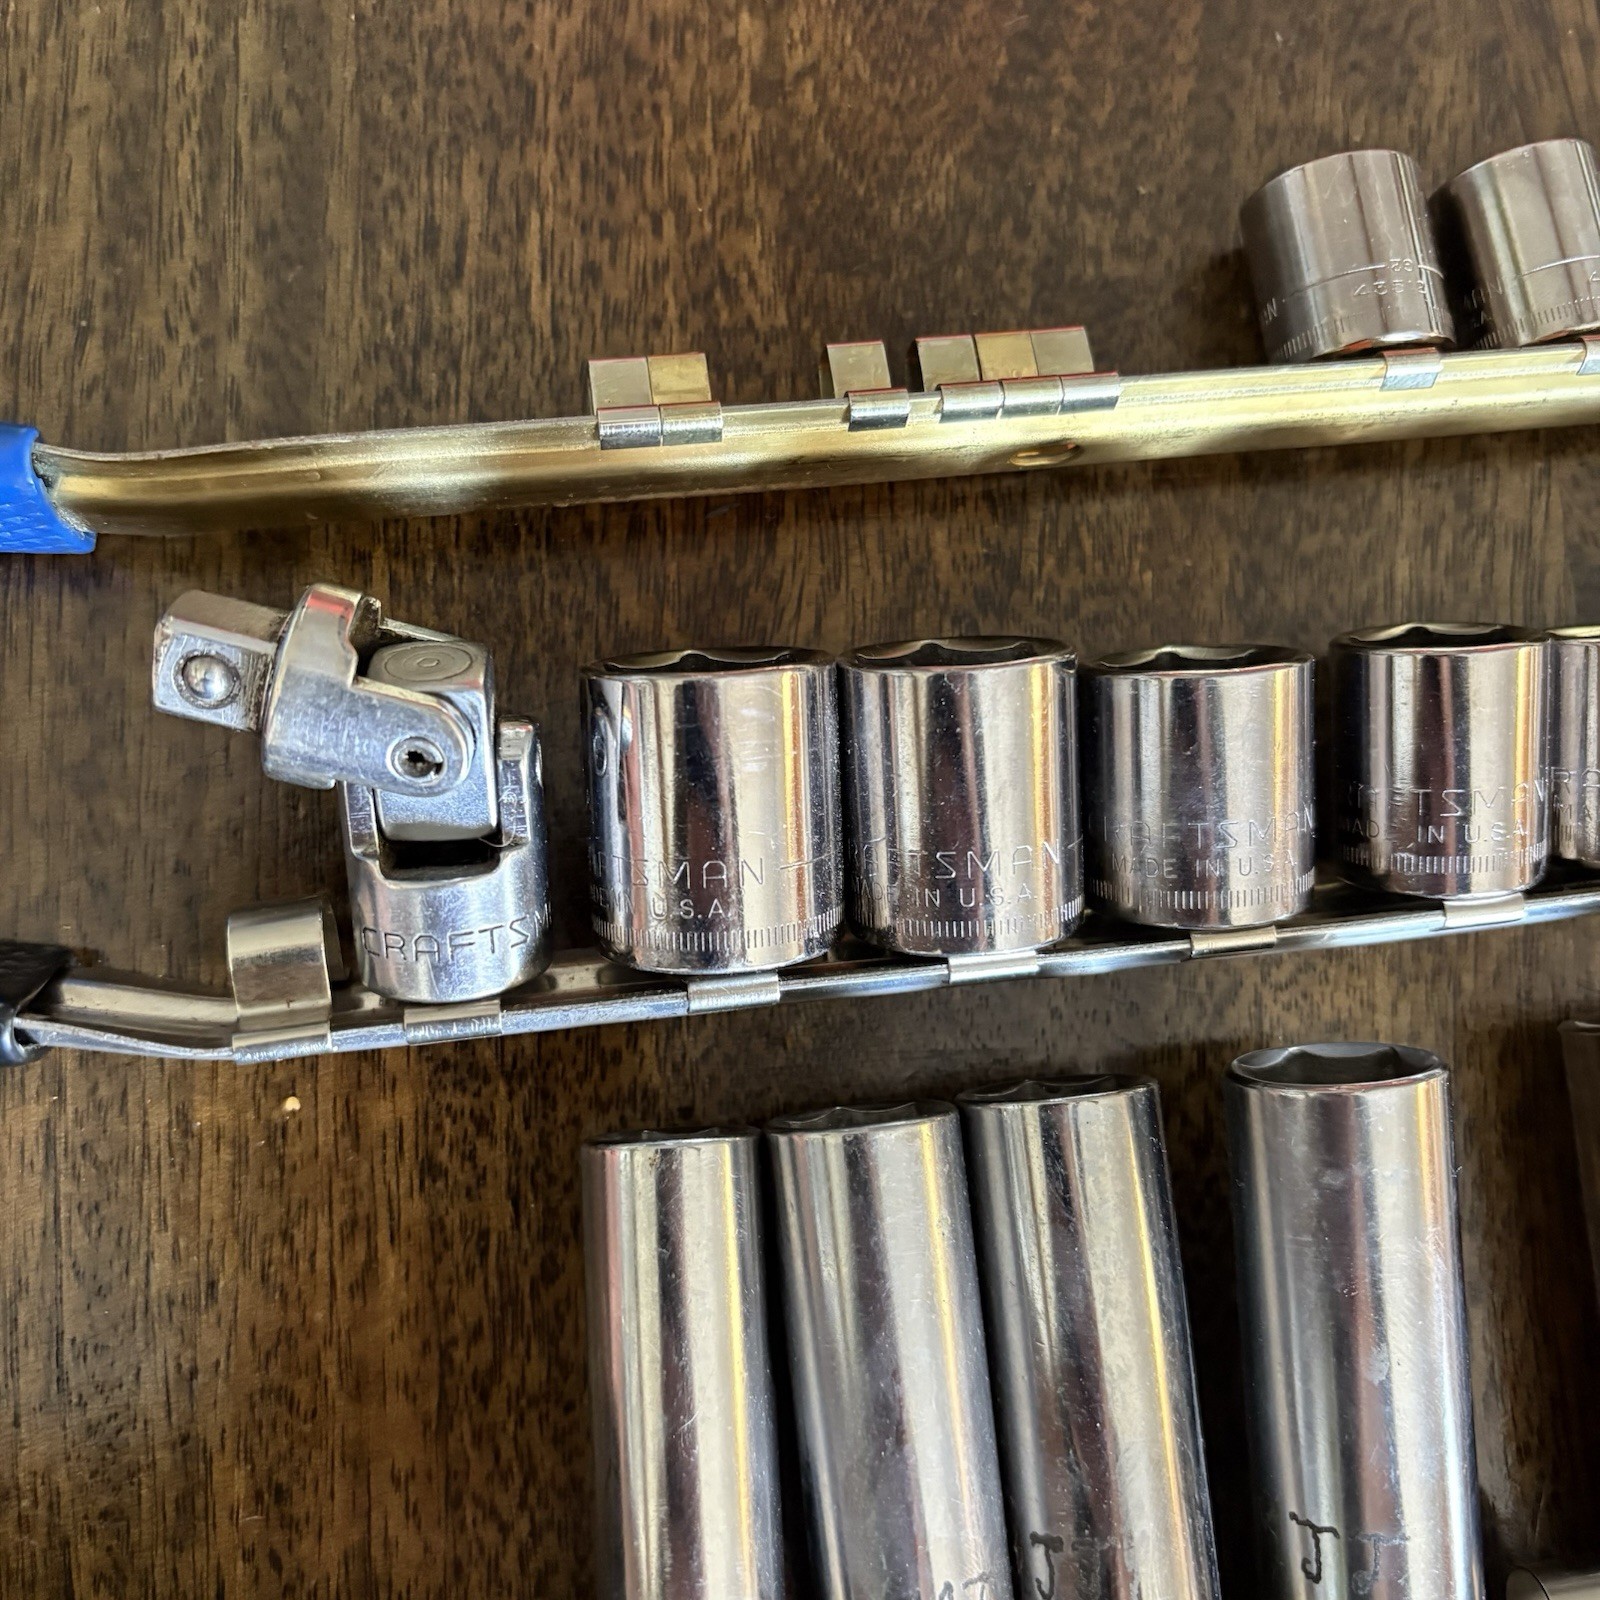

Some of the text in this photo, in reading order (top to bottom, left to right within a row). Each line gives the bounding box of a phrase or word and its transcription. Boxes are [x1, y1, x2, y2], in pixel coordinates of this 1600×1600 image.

[1416, 824, 1445, 844] IN
[1195, 858, 1221, 878] IN
[914, 887, 941, 908] IN
